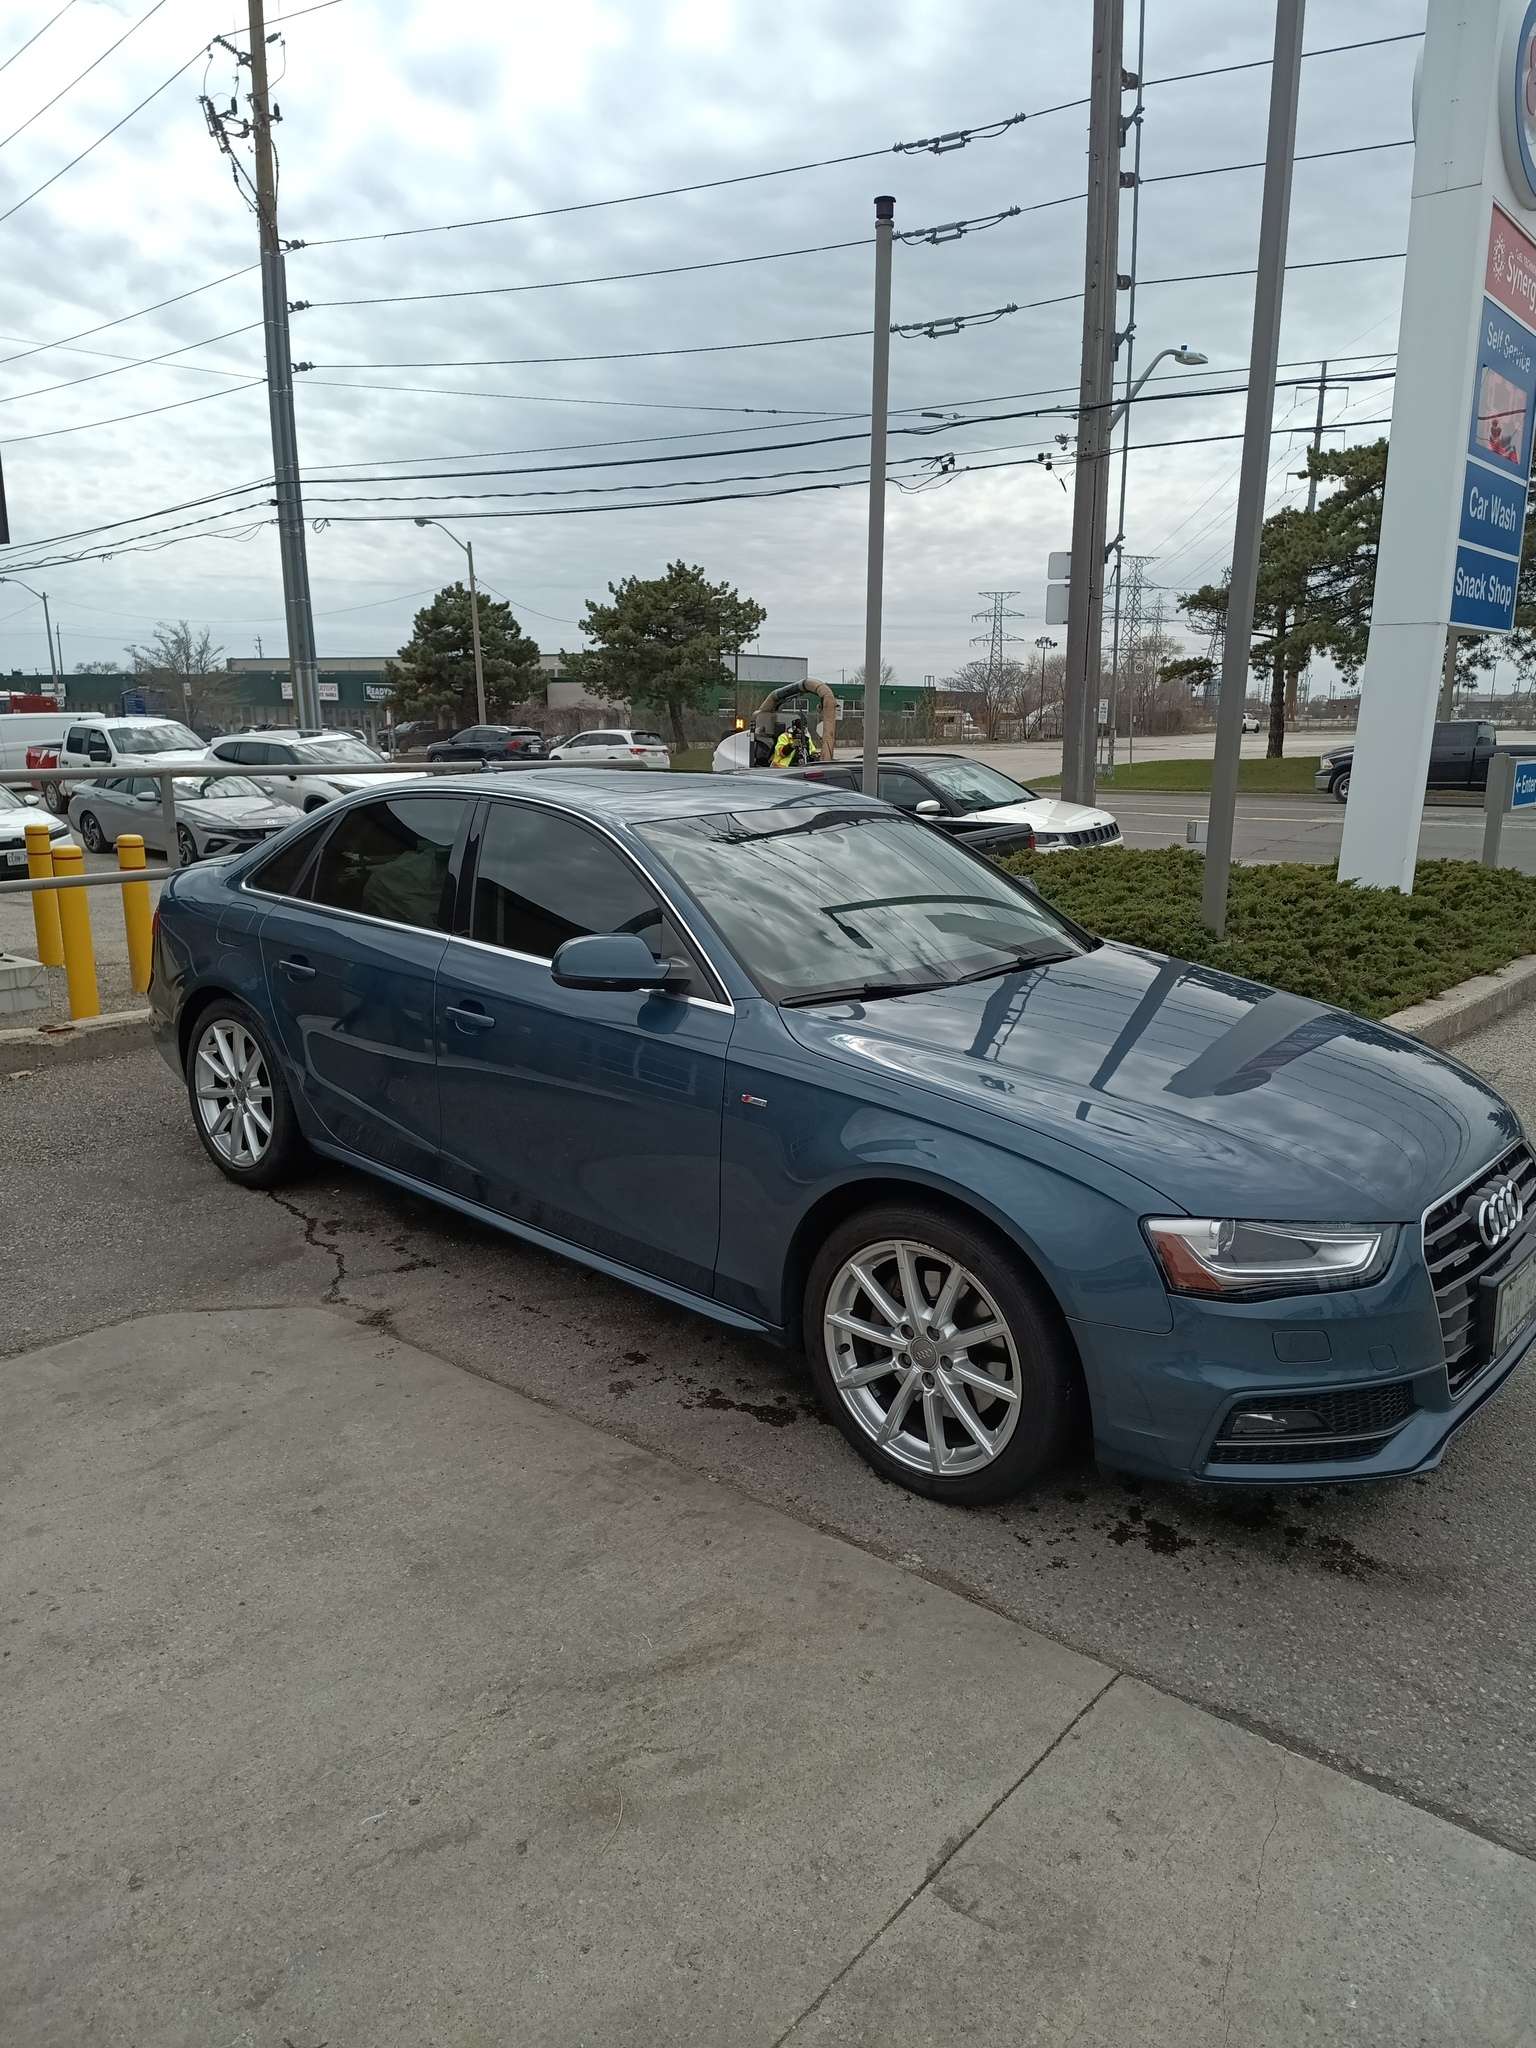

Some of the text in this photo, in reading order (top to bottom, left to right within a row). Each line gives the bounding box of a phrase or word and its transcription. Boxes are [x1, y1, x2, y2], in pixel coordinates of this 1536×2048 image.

[1506, 254, 1536, 313] Synerg
[1487, 321, 1531, 373] Self Service
[1470, 486, 1516, 532] Car Wash
[1455, 566, 1511, 612] Snack Shop
